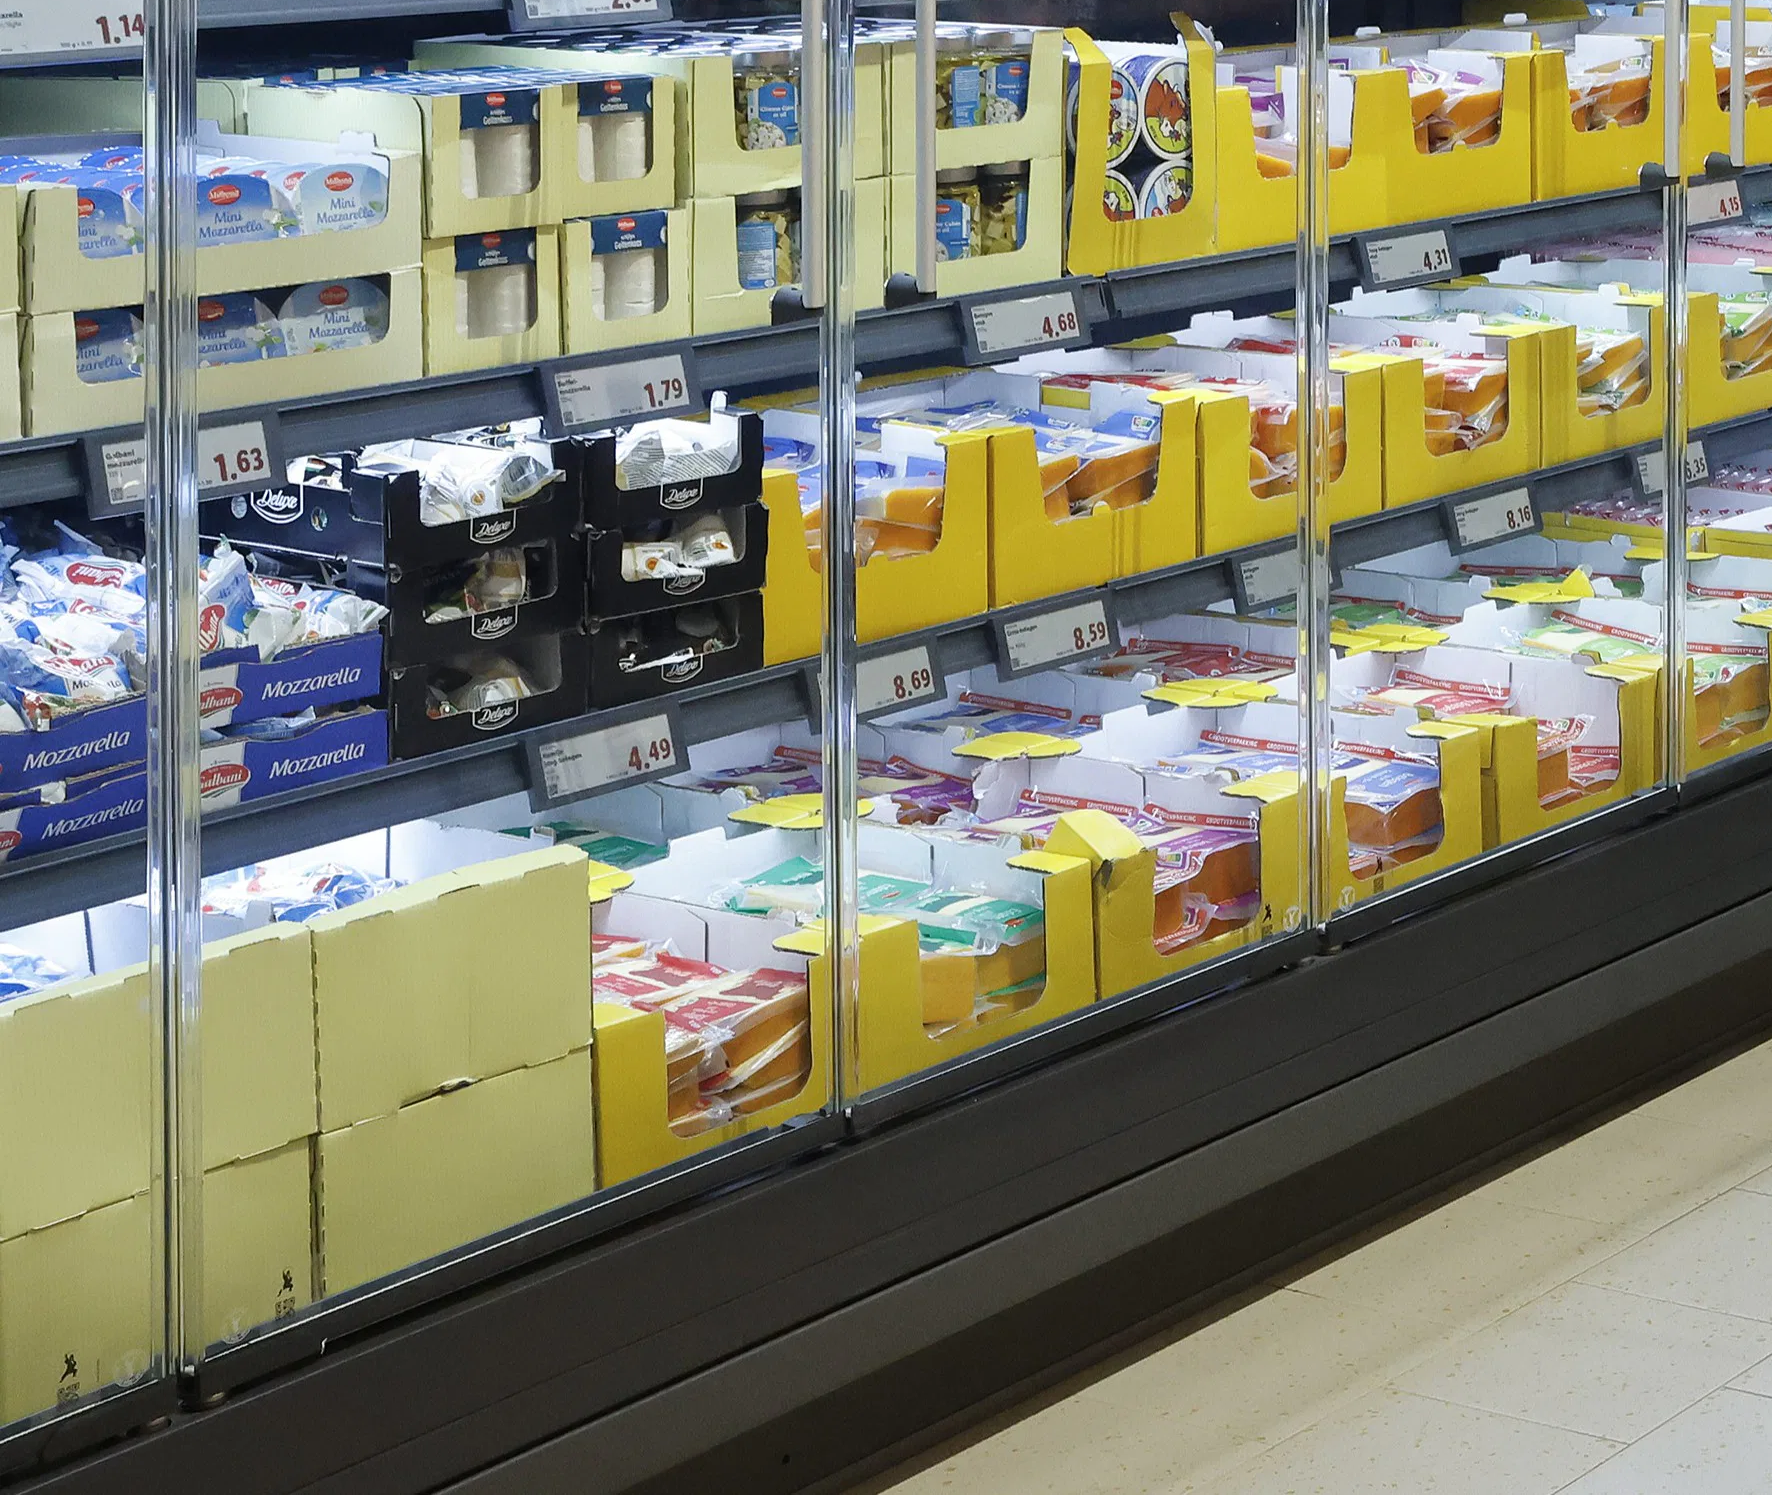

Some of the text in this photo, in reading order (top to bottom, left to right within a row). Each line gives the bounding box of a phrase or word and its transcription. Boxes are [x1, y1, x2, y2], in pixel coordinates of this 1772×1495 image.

[95, 12, 145, 45] 1.14
[329, 197, 356, 211] Mini
[1719, 195, 1740, 218] 4.15
[213, 211, 243, 224] Mini
[316, 206, 376, 225] Mozzarella
[199, 220, 265, 240] Mozzarella
[79, 236, 118, 251] zarella
[1423, 248, 1449, 272] 4.31
[323, 310, 352, 326] Mini
[1042, 312, 1077, 338] 4.68
[308, 323, 371, 339] Mozzarella
[198, 337, 247, 354] zzarella
[77, 355, 124, 374] zzarella
[643, 377, 684, 408] 1.79
[106, 457, 146, 469] mozzarell
[212, 447, 265, 482] 1.63
[256, 488, 298, 509] Deluxe
[664, 486, 699, 504] Deluxe
[1505, 503, 1532, 530] 8.16
[477, 519, 512, 537] Deluxe
[480, 614, 514, 632] Deluxe
[1073, 620, 1106, 651] 8.59
[261, 666, 362, 701] Mozzarella
[893, 667, 931, 699] 8.69
[200, 693, 236, 711] albani
[481, 705, 514, 723] Deluxe
[23, 731, 130, 773] Mozzarella
[628, 738, 671, 772] 4.49
[1266, 741, 1300, 755] GROOTVERPA
[268, 742, 366, 780] Mozzarella
[41, 797, 144, 841] Mozzarella
